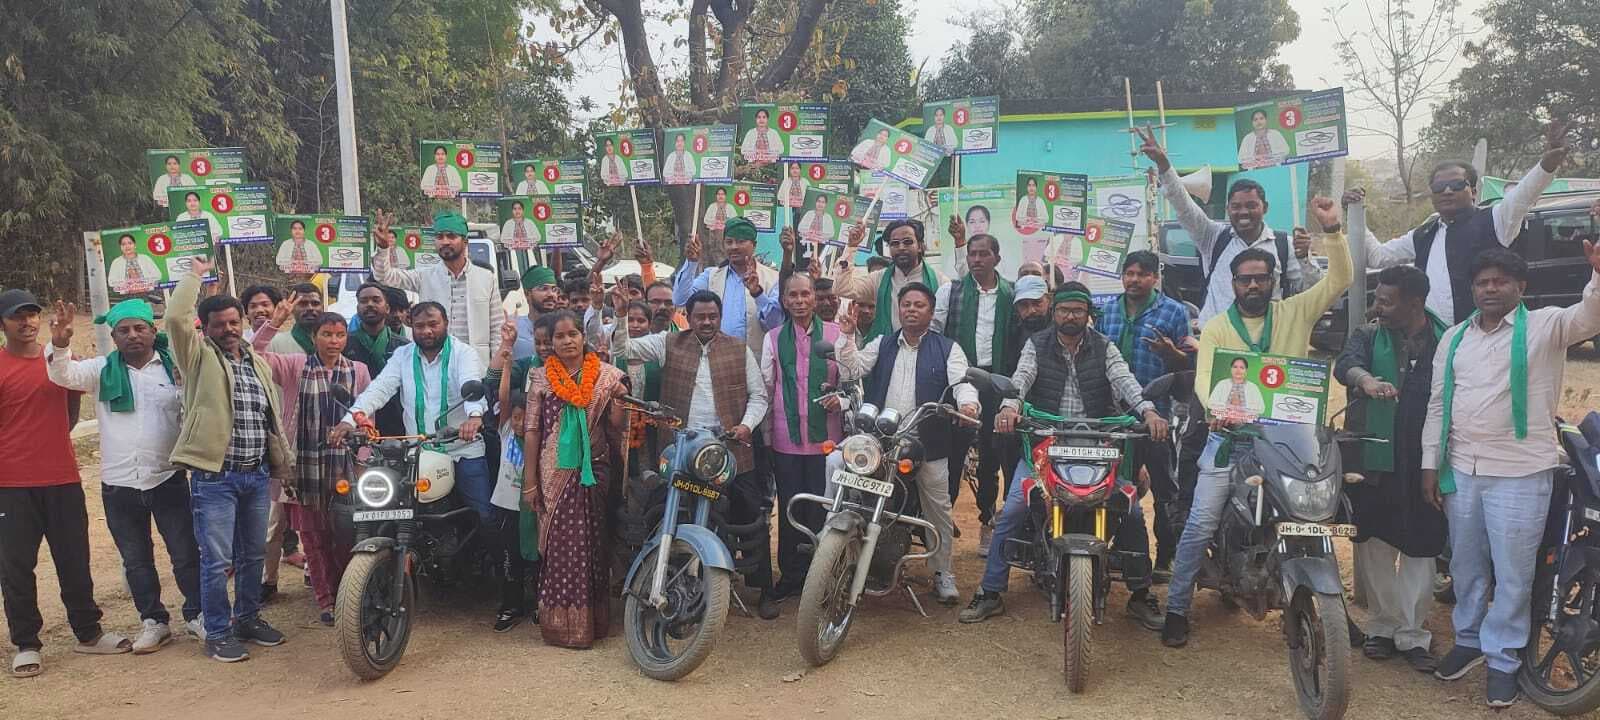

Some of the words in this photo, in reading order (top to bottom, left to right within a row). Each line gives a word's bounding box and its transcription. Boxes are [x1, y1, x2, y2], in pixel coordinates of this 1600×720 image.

[783, 115, 792, 129] 3
[957, 111, 965, 124] 3
[1286, 110, 1295, 126] 3
[623, 142, 630, 155] 3
[696, 138, 704, 151] 3
[898, 141, 909, 152] 3
[461, 153, 469, 166] 3
[197, 161, 206, 174] 3
[813, 166, 821, 179] 3
[548, 169, 555, 180] 3
[1048, 184, 1055, 199] 3
[218, 197, 228, 211] 3
[738, 193, 746, 205] 3
[537, 206, 546, 219] 3
[838, 204, 847, 217] 3
[321, 227, 330, 241] 3
[1088, 228, 1097, 241] 3
[154, 237, 165, 252] 3
[409, 237, 417, 248] 3
[1266, 368, 1278, 385] 3
